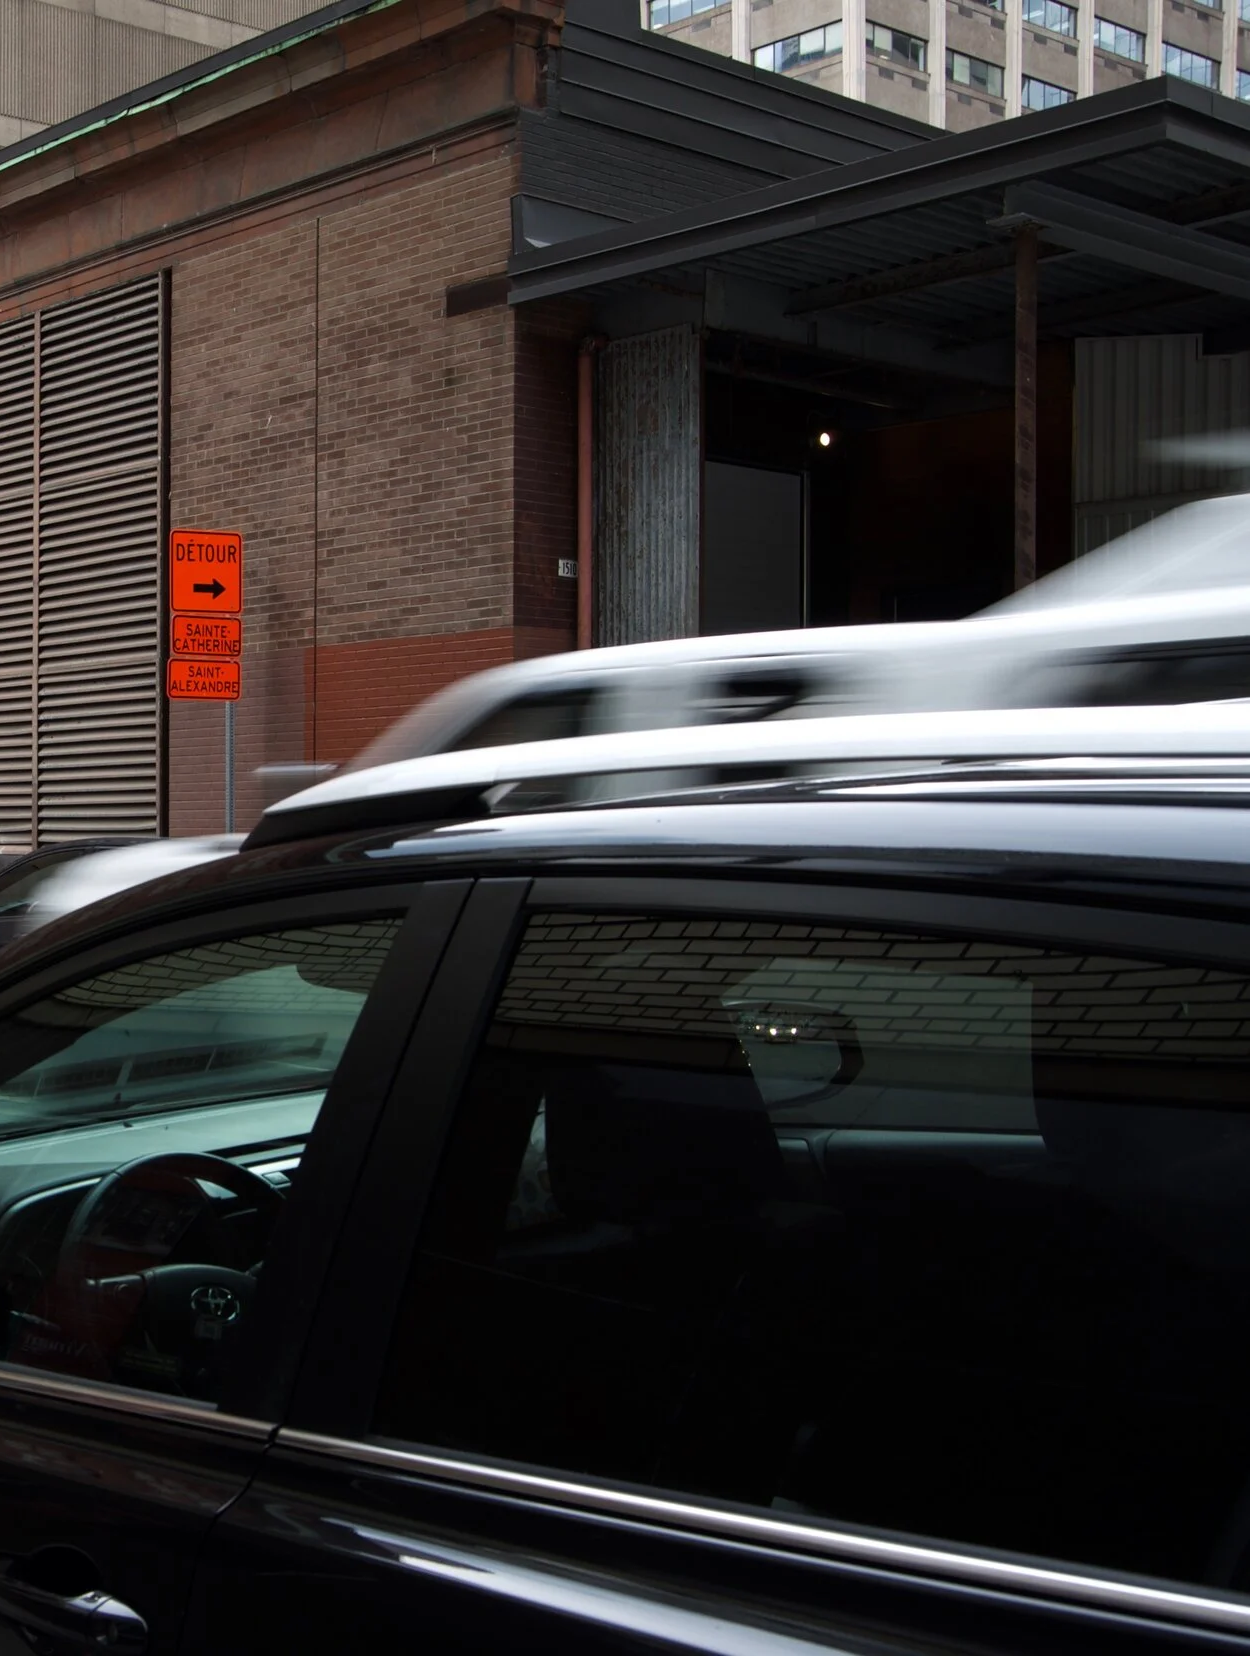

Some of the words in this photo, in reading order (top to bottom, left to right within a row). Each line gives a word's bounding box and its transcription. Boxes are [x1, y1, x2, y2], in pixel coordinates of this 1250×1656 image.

[176, 539, 237, 563] DÉTOUR
[186, 623, 230, 638] SAINTE-
[174, 638, 240, 653] CATHERINE
[188, 666, 225, 679] SAINT-
[170, 680, 239, 693] ALEXANDRE
